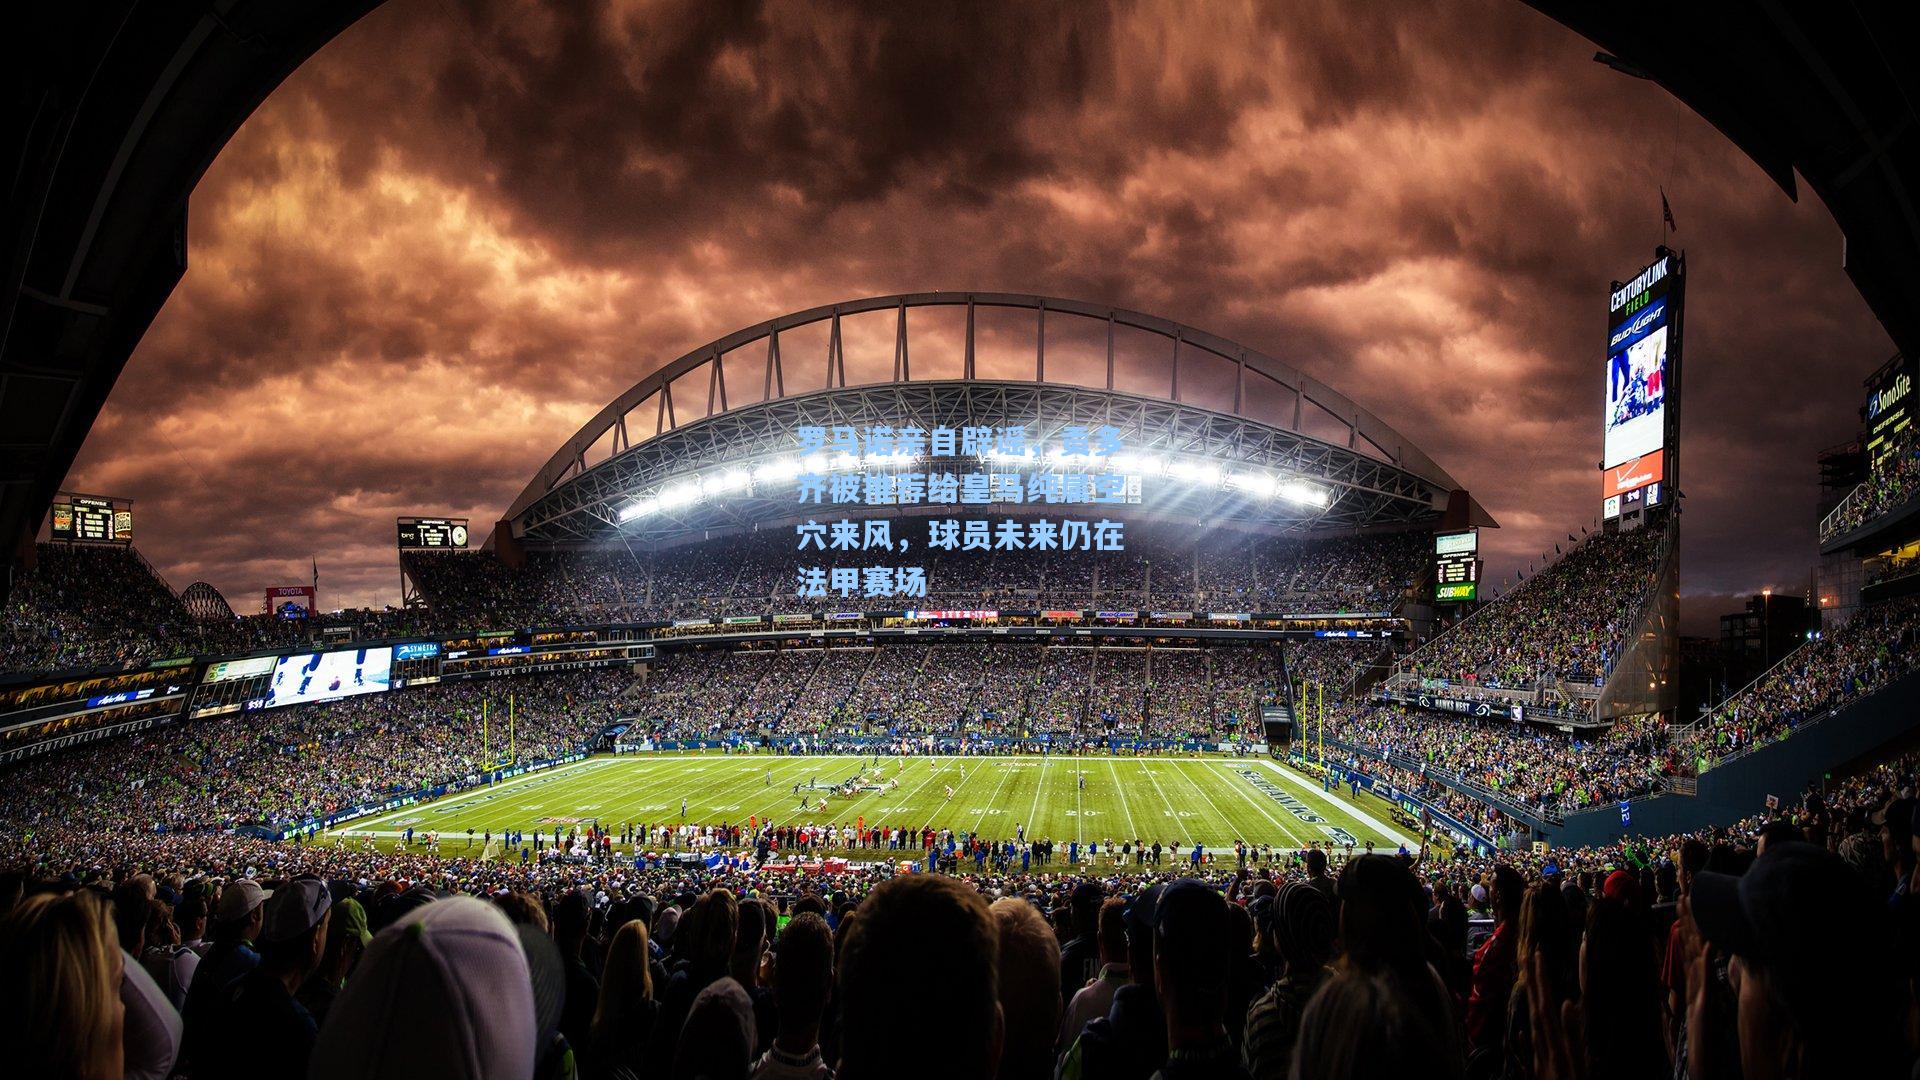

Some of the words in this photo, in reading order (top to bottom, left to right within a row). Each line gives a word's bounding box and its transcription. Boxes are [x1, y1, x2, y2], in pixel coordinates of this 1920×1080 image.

[1611, 256, 1668, 312] CENTURYLINK
[1625, 290, 1649, 316] FIELD
[1610, 327, 1633, 346] BUD
[1632, 305, 1664, 333] LIGHT
[1877, 373, 1911, 414] SonoSite
[80, 499, 107, 507] OFFENSE
[278, 588, 303, 596] TOYOTA
[1437, 584, 1474, 599] SUBWAY
[409, 644, 438, 653] SYMETRA
[490, 669, 516, 677] HOME
[538, 664, 555, 672] THE
[561, 661, 584, 670] 12TH
[9, 750, 24, 763] TO
[29, 728, 112, 756] CENTURYLINK
[118, 720, 152, 735] FIELD
[1619, 805, 1631, 822] 12
